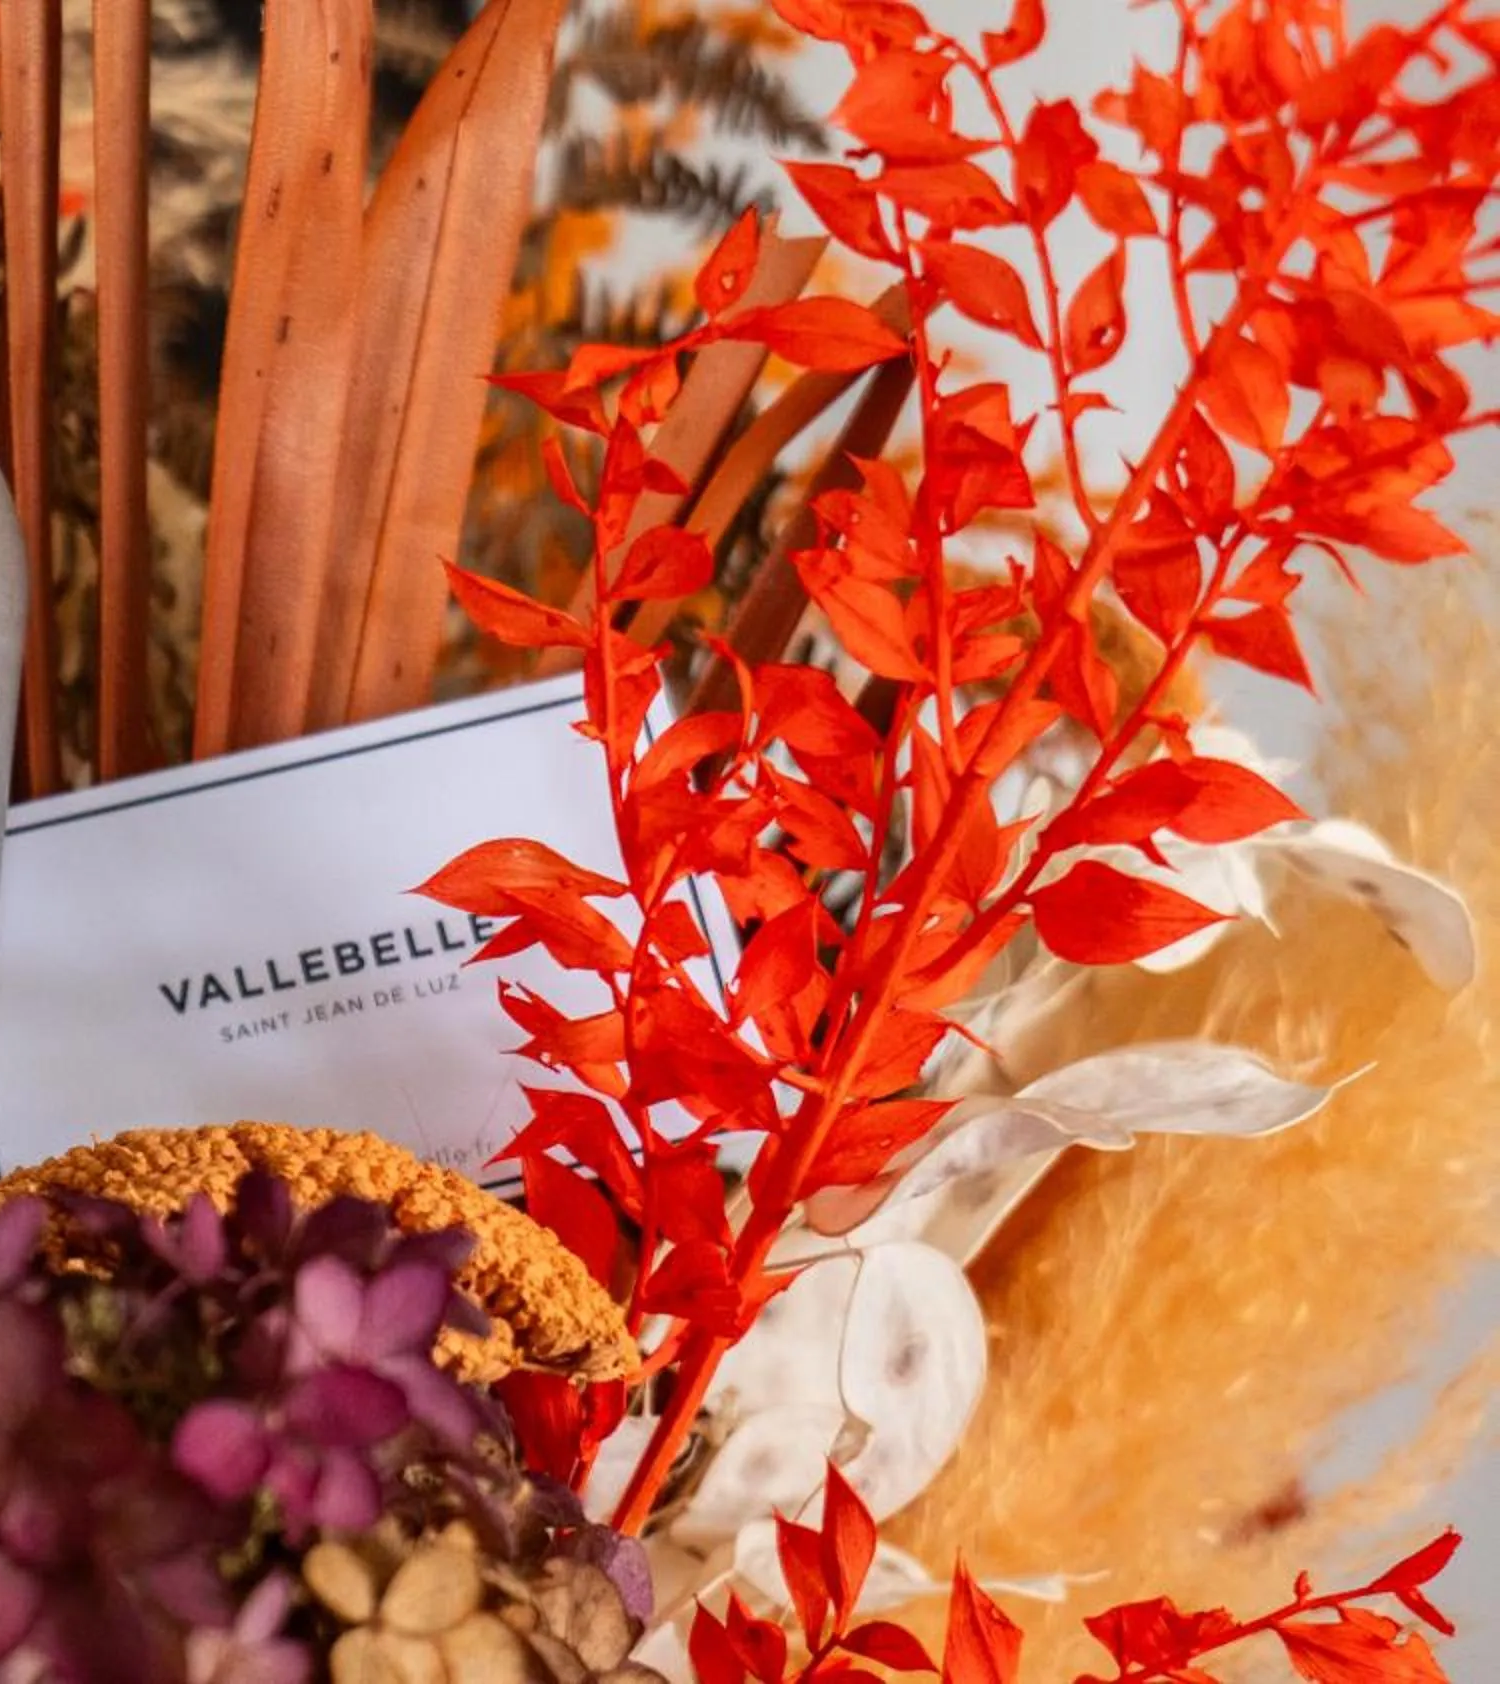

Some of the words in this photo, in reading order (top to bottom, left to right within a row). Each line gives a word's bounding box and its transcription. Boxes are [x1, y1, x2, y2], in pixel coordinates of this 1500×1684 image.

[159, 913, 495, 1015] VALLEBELLE
[220, 1012, 291, 1043] SAINT
[303, 998, 364, 1025] JEAN
[373, 987, 406, 1008] DE
[414, 973, 462, 999] LUZ
